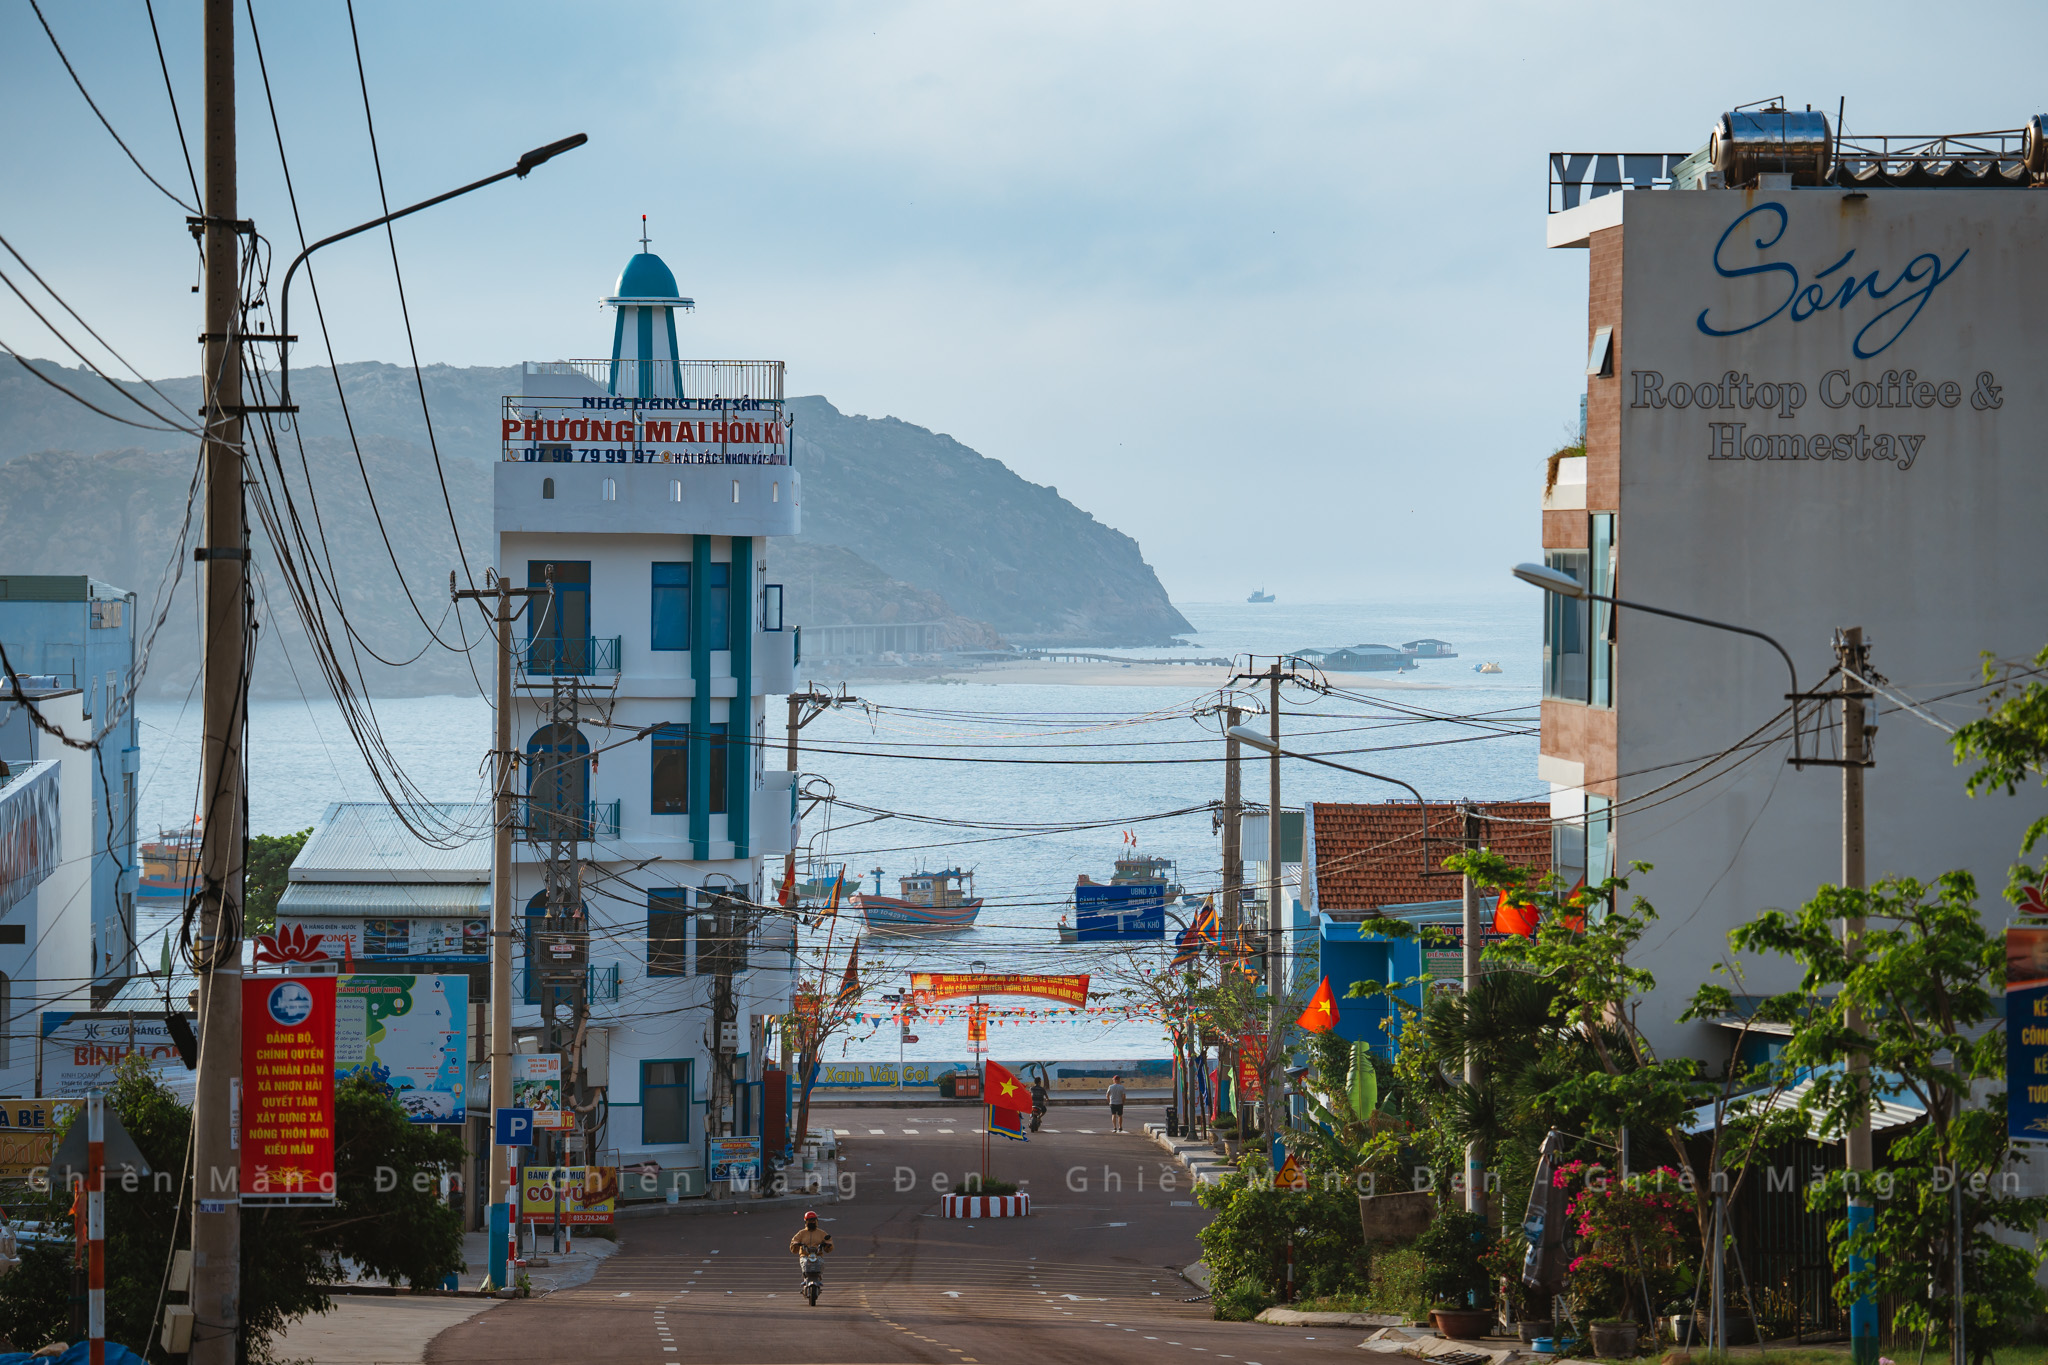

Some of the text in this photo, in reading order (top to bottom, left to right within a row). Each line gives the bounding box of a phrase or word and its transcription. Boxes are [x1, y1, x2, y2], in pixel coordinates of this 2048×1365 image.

[1697, 201, 1970, 360] Sóng
[1630, 369, 2004, 419] Rooftop Coffee &
[582, 393, 760, 411] NHÀ HÀNG HẢI SẢN
[502, 417, 634, 442] PHƯƠNG
[645, 420, 706, 442] MAI
[711, 415, 760, 443] HÒN
[1708, 422, 1926, 470] Homestay
[524, 448, 656, 463] 07 96 79 99 97
[1130, 887, 1147, 896] UBND
[370, 986, 382, 994] QUY
[266, 1030, 295, 1044] ĐẢNG
[256, 1048, 288, 1060] CHÍNH
[256, 1063, 324, 1076] VÀ NHÂN DÂN
[825, 1064, 929, 1087] Xanh Vẫy Gọi
[258, 1078, 322, 1091] XÃ NHƠN HẢI
[262, 1095, 318, 1108] QUYẾT TÂM
[18, 1103, 46, 1127] BÈ
[257, 1111, 323, 1125] XÂY DỰNG XÃ
[249, 1126, 329, 1139] NÔNG THÔN MỚI
[510, 1117, 528, 1138] P
[264, 1141, 314, 1155] KIỂU MẪU
[528, 1169, 549, 1180] BÁNH
[527, 1182, 554, 1202] CÔ
